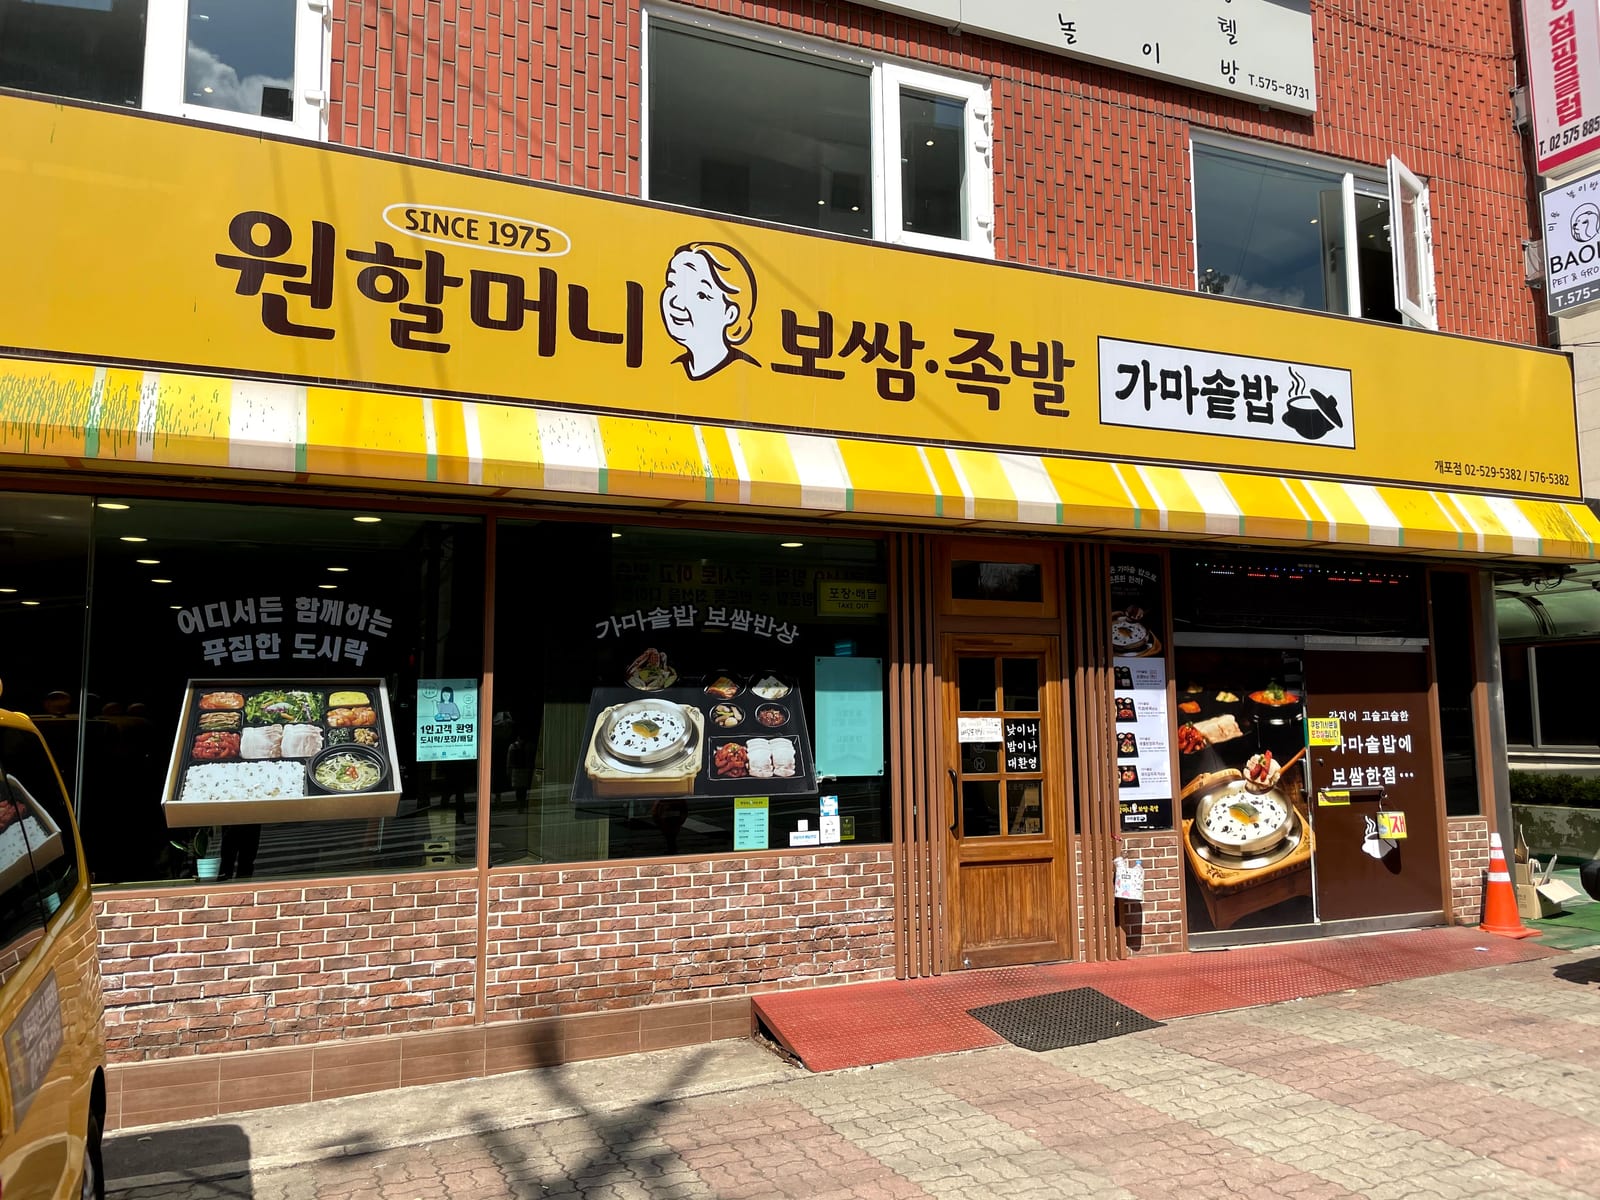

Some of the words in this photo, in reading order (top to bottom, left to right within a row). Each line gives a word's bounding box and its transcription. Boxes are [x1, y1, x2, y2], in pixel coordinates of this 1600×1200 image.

[1549, 9, 1583, 127] 점핑클럽
[1248, 74, 1310, 100] T.575-8731
[405, 208, 479, 240] SINCE
[488, 220, 551, 252] 1975
[1550, 241, 1600, 275] BAO
[215, 210, 644, 369] 원할머니
[1115, 359, 1279, 425] 가마솥밥
[1434, 460, 1462, 476] 개포점
[1464, 463, 1522, 481] 02-529-5382
[1529, 470, 1570, 486] 576-5382
[177, 596, 284, 634] 어디서든
[295, 596, 393, 638] 함께하는
[595, 604, 698, 639] 가마솥밥
[704, 605, 800, 644] 보쌈반상
[202, 633, 282, 666] 푸짐한
[292, 633, 369, 667] 도시락
[420, 724, 452, 735] 1인고객
[456, 723, 474, 734] 환영
[1006, 723, 1037, 737] 낮이나
[1362, 710, 1409, 722] 고슬고슬한
[1006, 740, 1038, 753] 밤이나
[1007, 756, 1037, 770] 대환영
